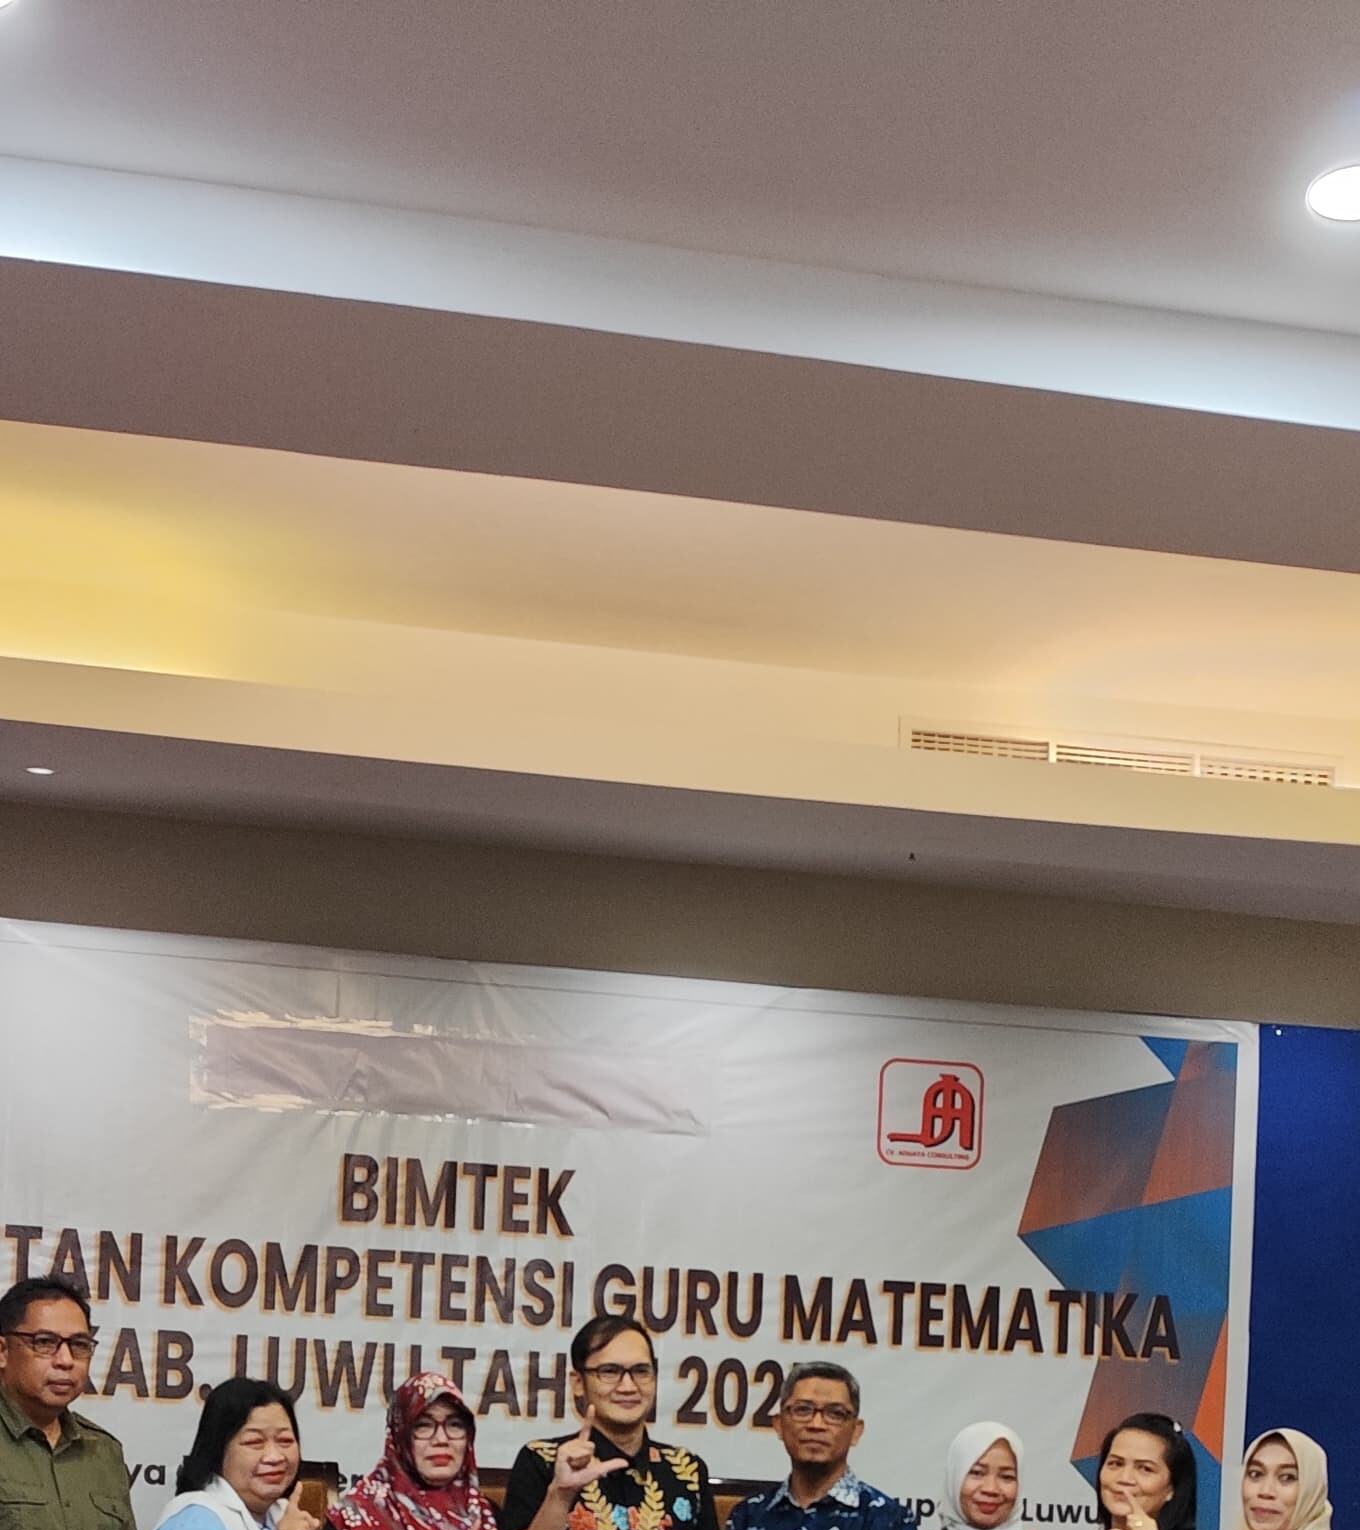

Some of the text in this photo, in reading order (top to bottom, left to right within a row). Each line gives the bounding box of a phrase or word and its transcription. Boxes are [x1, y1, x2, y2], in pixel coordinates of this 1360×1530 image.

[340, 1152, 576, 1238] BIMTEK
[161, 1234, 575, 1330] KOMPETENSI
[593, 1263, 764, 1339] GURU
[780, 1274, 1181, 1362] MATEMATIKA
[83, 1324, 213, 1400] AB.
[440, 1345, 658, 1424] TAH
[675, 1355, 798, 1428] 202
